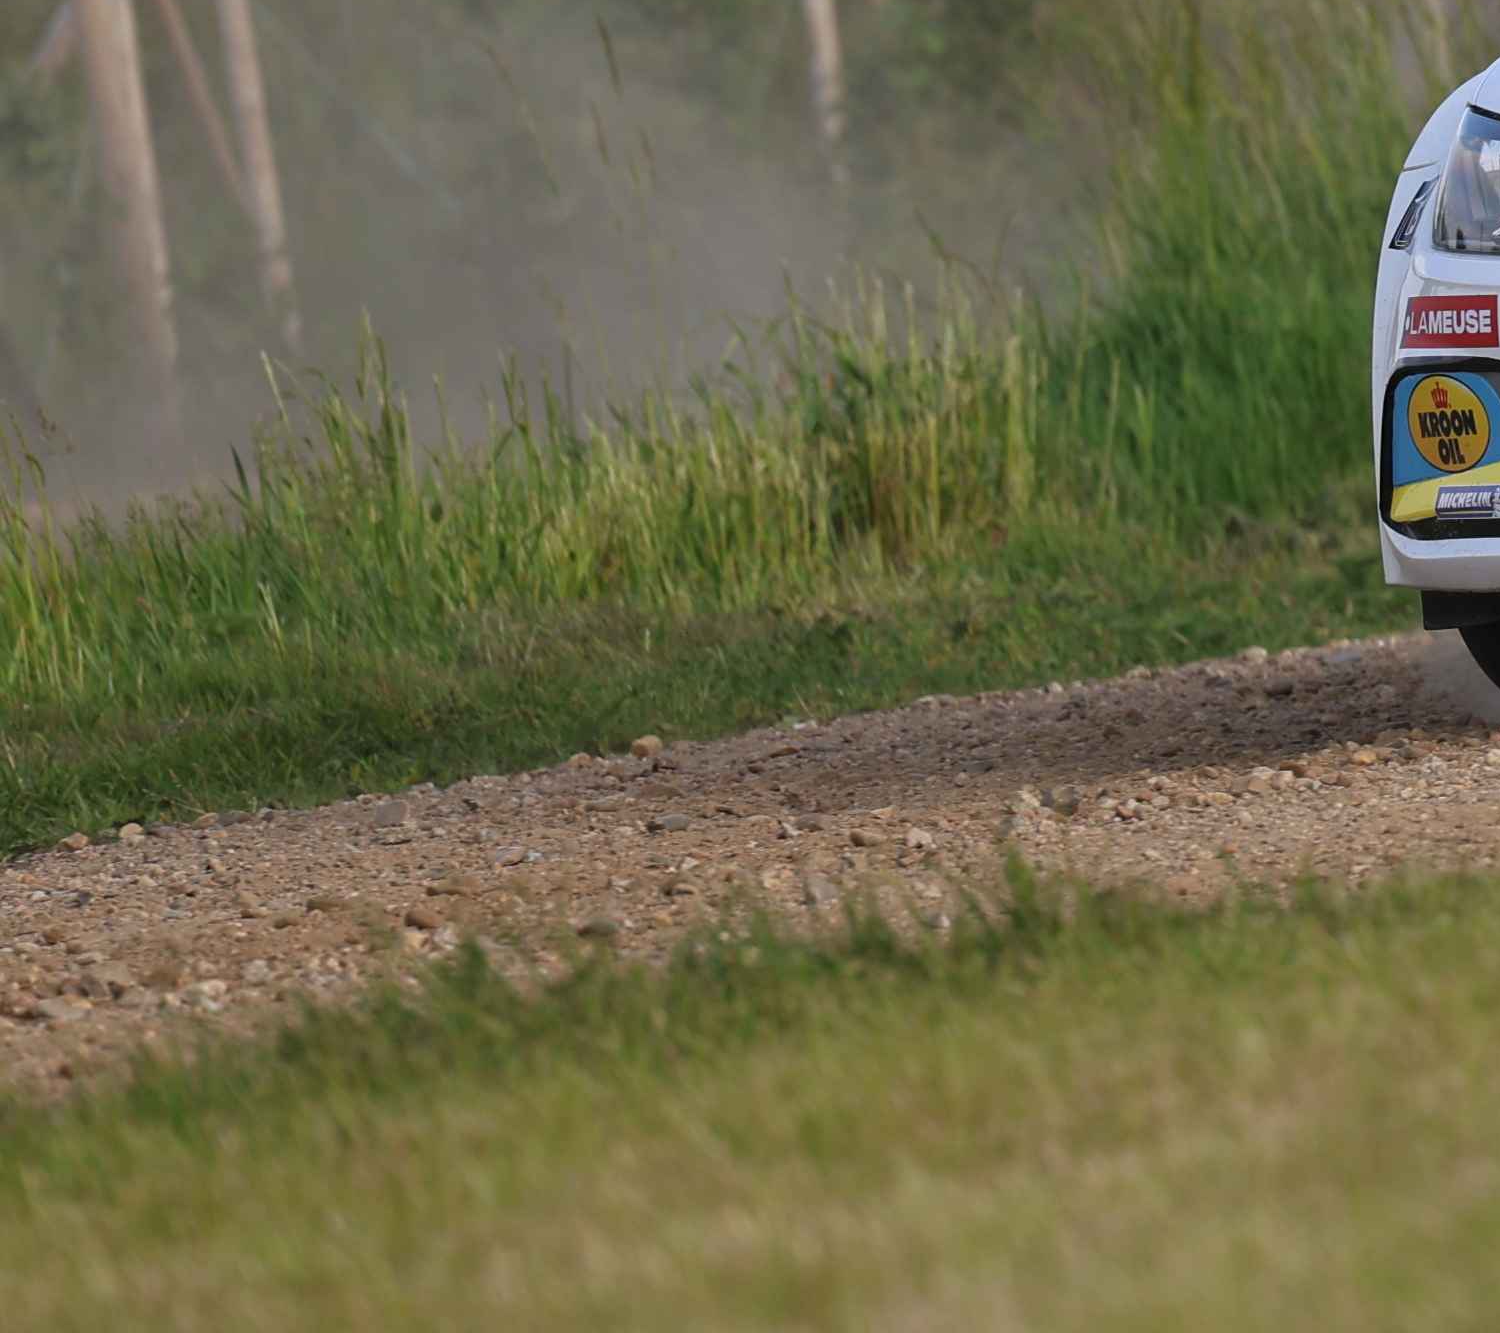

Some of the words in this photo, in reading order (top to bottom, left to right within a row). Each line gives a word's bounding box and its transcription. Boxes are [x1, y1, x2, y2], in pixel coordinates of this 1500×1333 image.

[1410, 309, 1493, 334] LAMEUSE
[1418, 409, 1478, 438] KROON
[1437, 439, 1466, 465] OIL
[1438, 492, 1494, 509] MICHELIN
